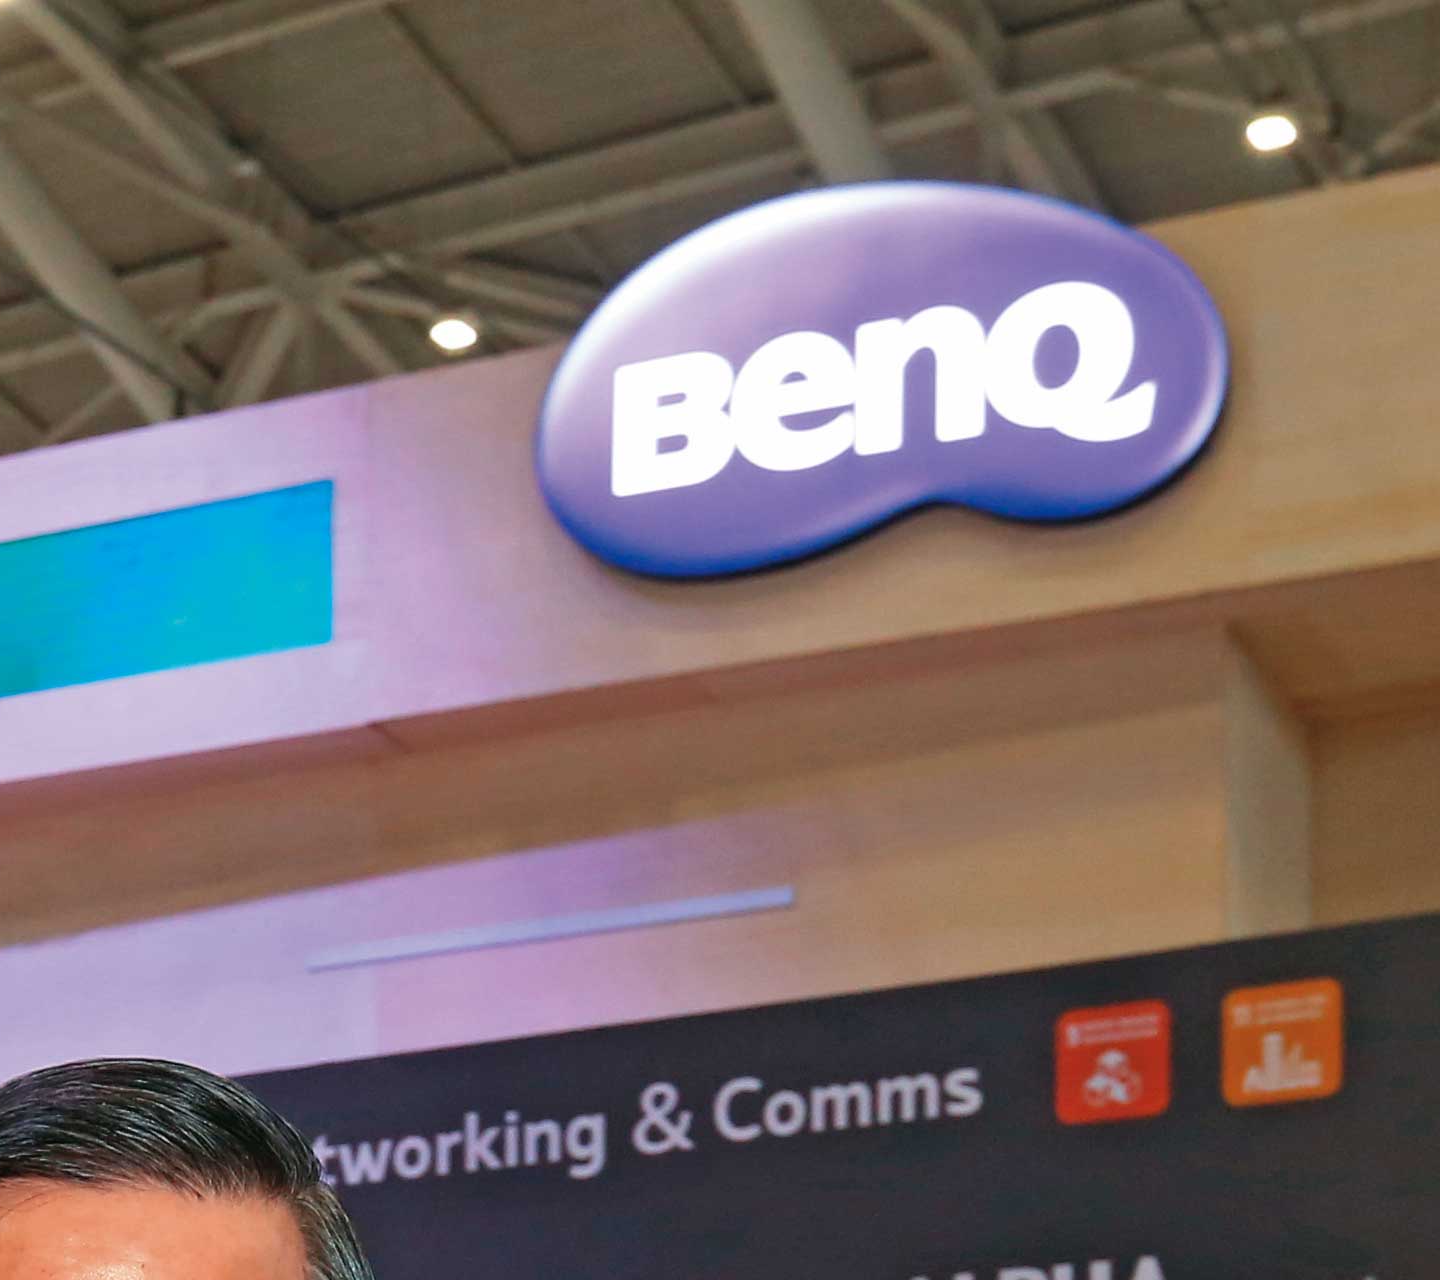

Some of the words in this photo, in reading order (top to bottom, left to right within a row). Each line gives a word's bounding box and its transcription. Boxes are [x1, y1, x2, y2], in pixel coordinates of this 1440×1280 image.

[613, 281, 1156, 497] BenQ
[632, 1081, 694, 1155] &
[712, 1066, 984, 1142] Comms
